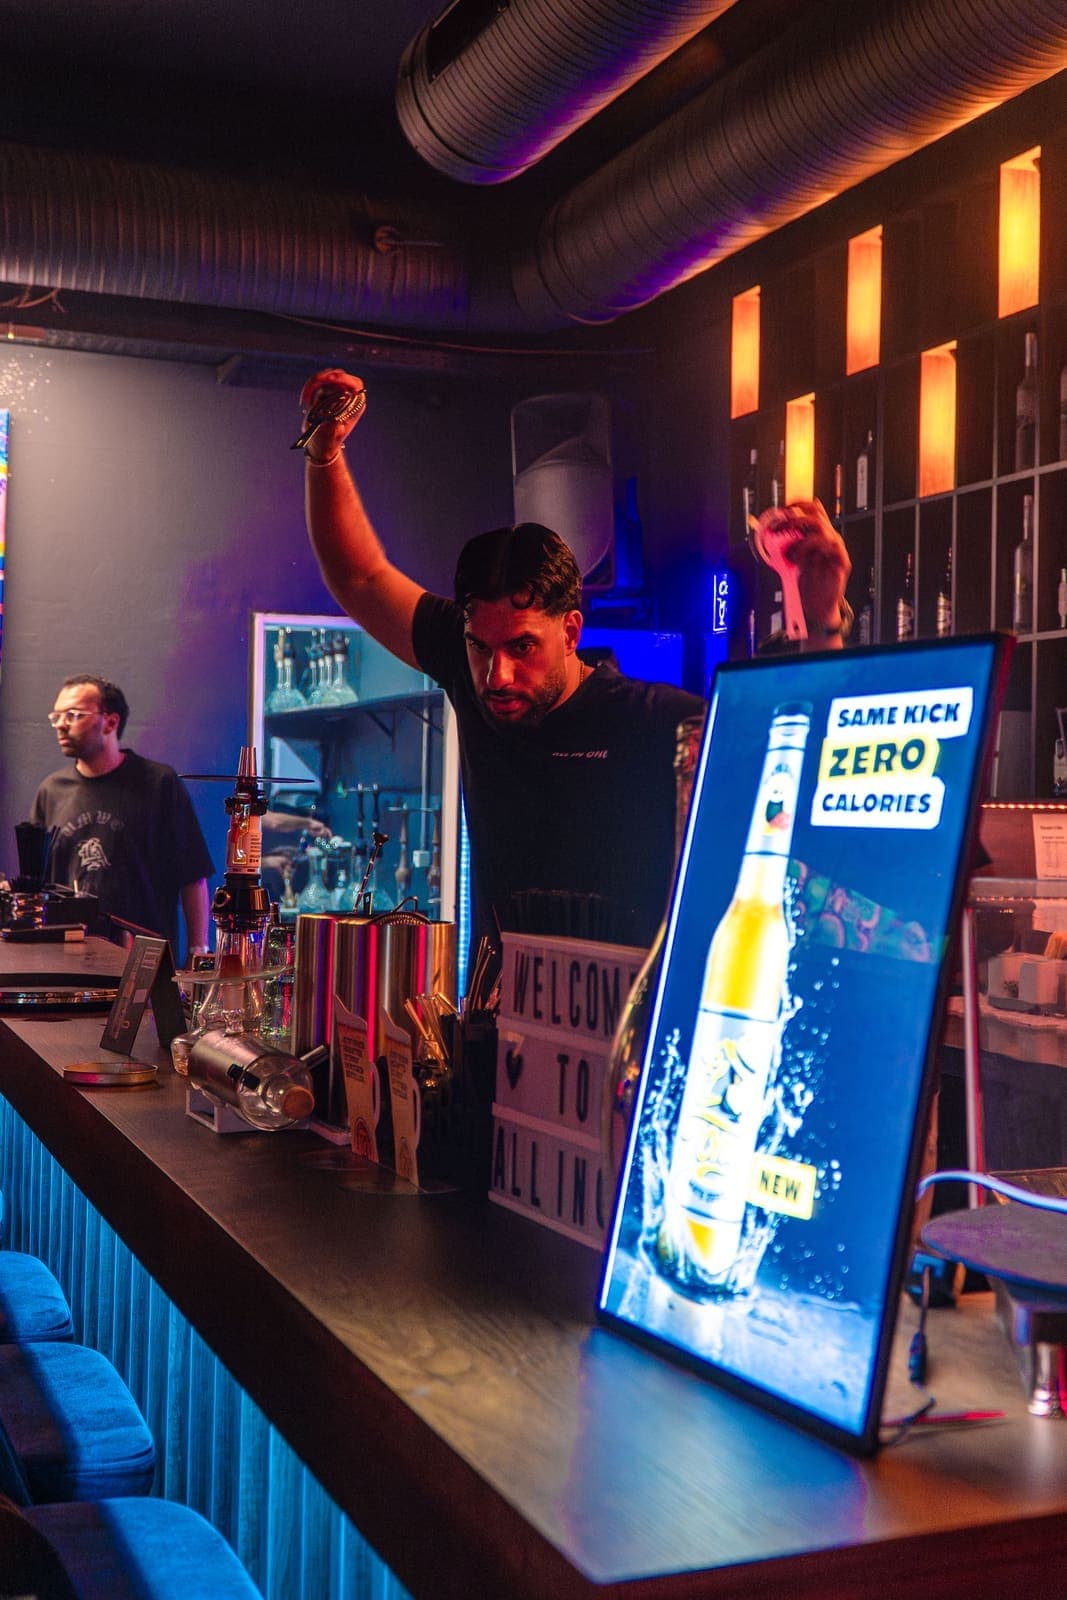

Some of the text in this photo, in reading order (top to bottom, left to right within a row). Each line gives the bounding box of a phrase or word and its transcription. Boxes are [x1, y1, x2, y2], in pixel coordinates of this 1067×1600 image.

[837, 703, 961, 728] SAME KICK
[828, 738, 926, 778] ZERO
[822, 793, 932, 813] CALORIES
[513, 949, 638, 1037] WELCOM
[556, 1053, 590, 1123] TO
[494, 1126, 541, 1208] ALL
[760, 1170, 802, 1201] NEW
